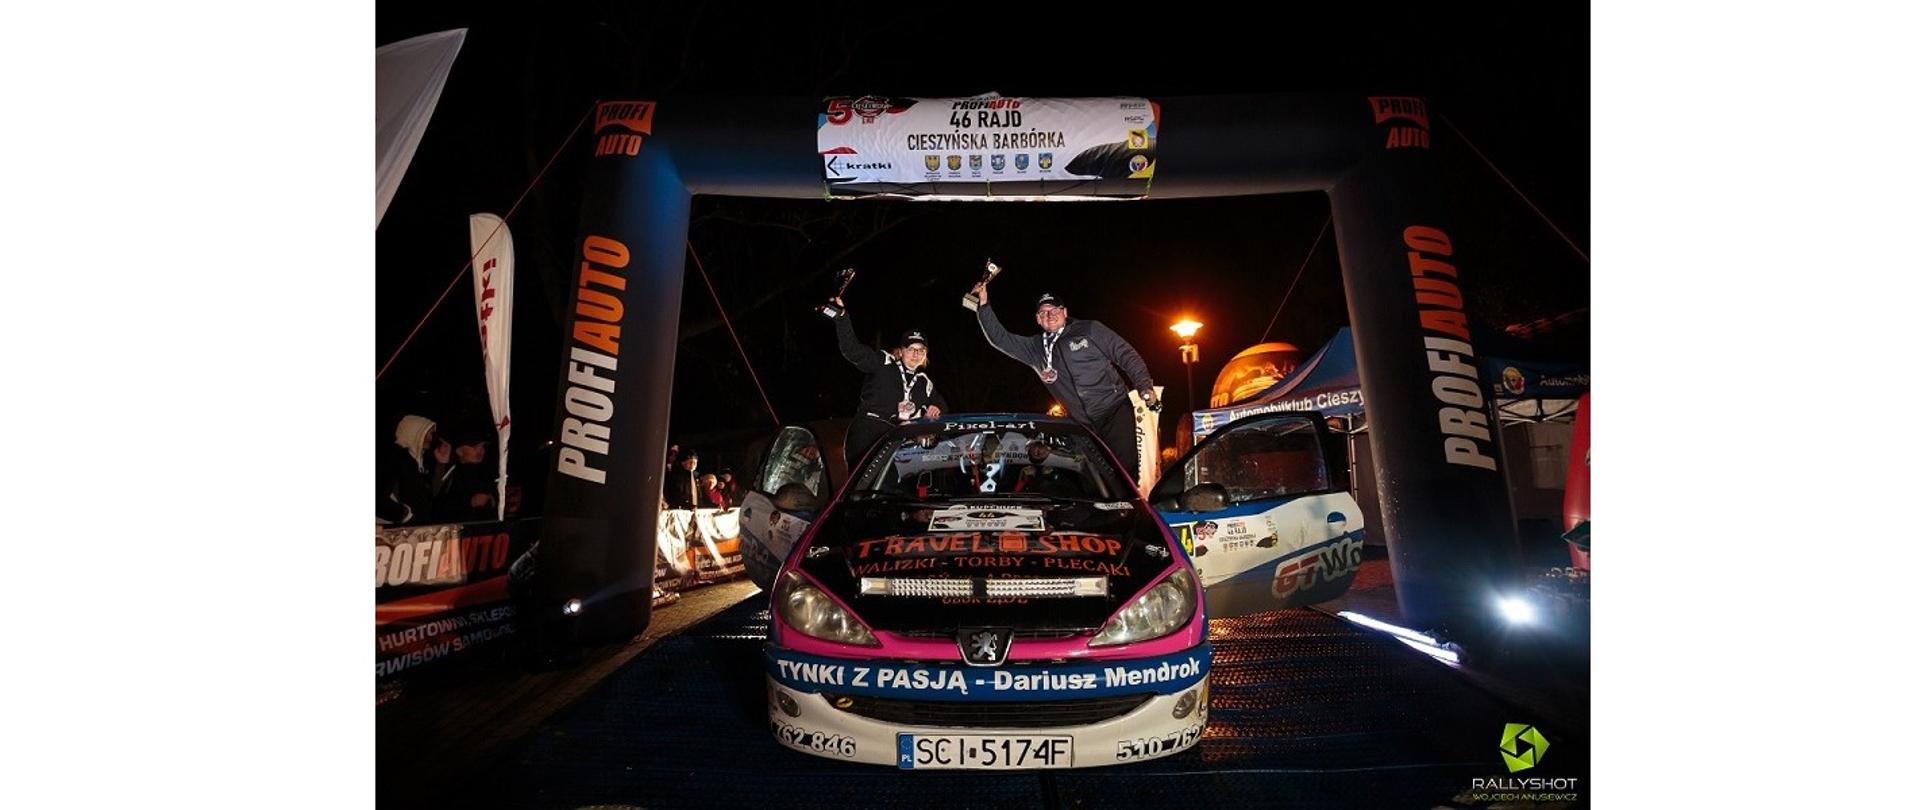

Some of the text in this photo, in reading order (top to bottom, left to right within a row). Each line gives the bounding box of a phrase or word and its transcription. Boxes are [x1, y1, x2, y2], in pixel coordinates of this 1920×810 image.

[601, 103, 649, 122] PROFI
[952, 99, 1022, 110] PROFIAUTO
[1378, 98, 1427, 118] PROFI
[950, 111, 1022, 128] 46 RAJD
[596, 134, 642, 157] AUTO
[907, 128, 1066, 151] CIESZYŃSKA BARBÓRKA
[1385, 126, 1430, 150] AUTO
[846, 162, 892, 170] kratki
[558, 235, 630, 485] PROFIAUTO
[1403, 225, 1497, 472] PROFIAUTO
[943, 420, 1036, 432] Pixel-art
[859, 532, 994, 558] TRAVEL
[1030, 534, 1121, 556] SHOP
[851, 557, 937, 577] WALIZKI
[954, 556, 1025, 567] TORBY
[1044, 556, 1132, 577] PLECAKI
[777, 660, 844, 685] TYNKI
[851, 668, 870, 687] Z
[877, 669, 968, 695] PASJĄ
[994, 670, 1097, 690] Dariusz
[1104, 657, 1201, 688] Mendrok
[810, 731, 857, 757] 846
[916, 738, 1069, 766] SCI 5174F
[1117, 736, 1164, 762] 510
[901, 754, 912, 763] PL
